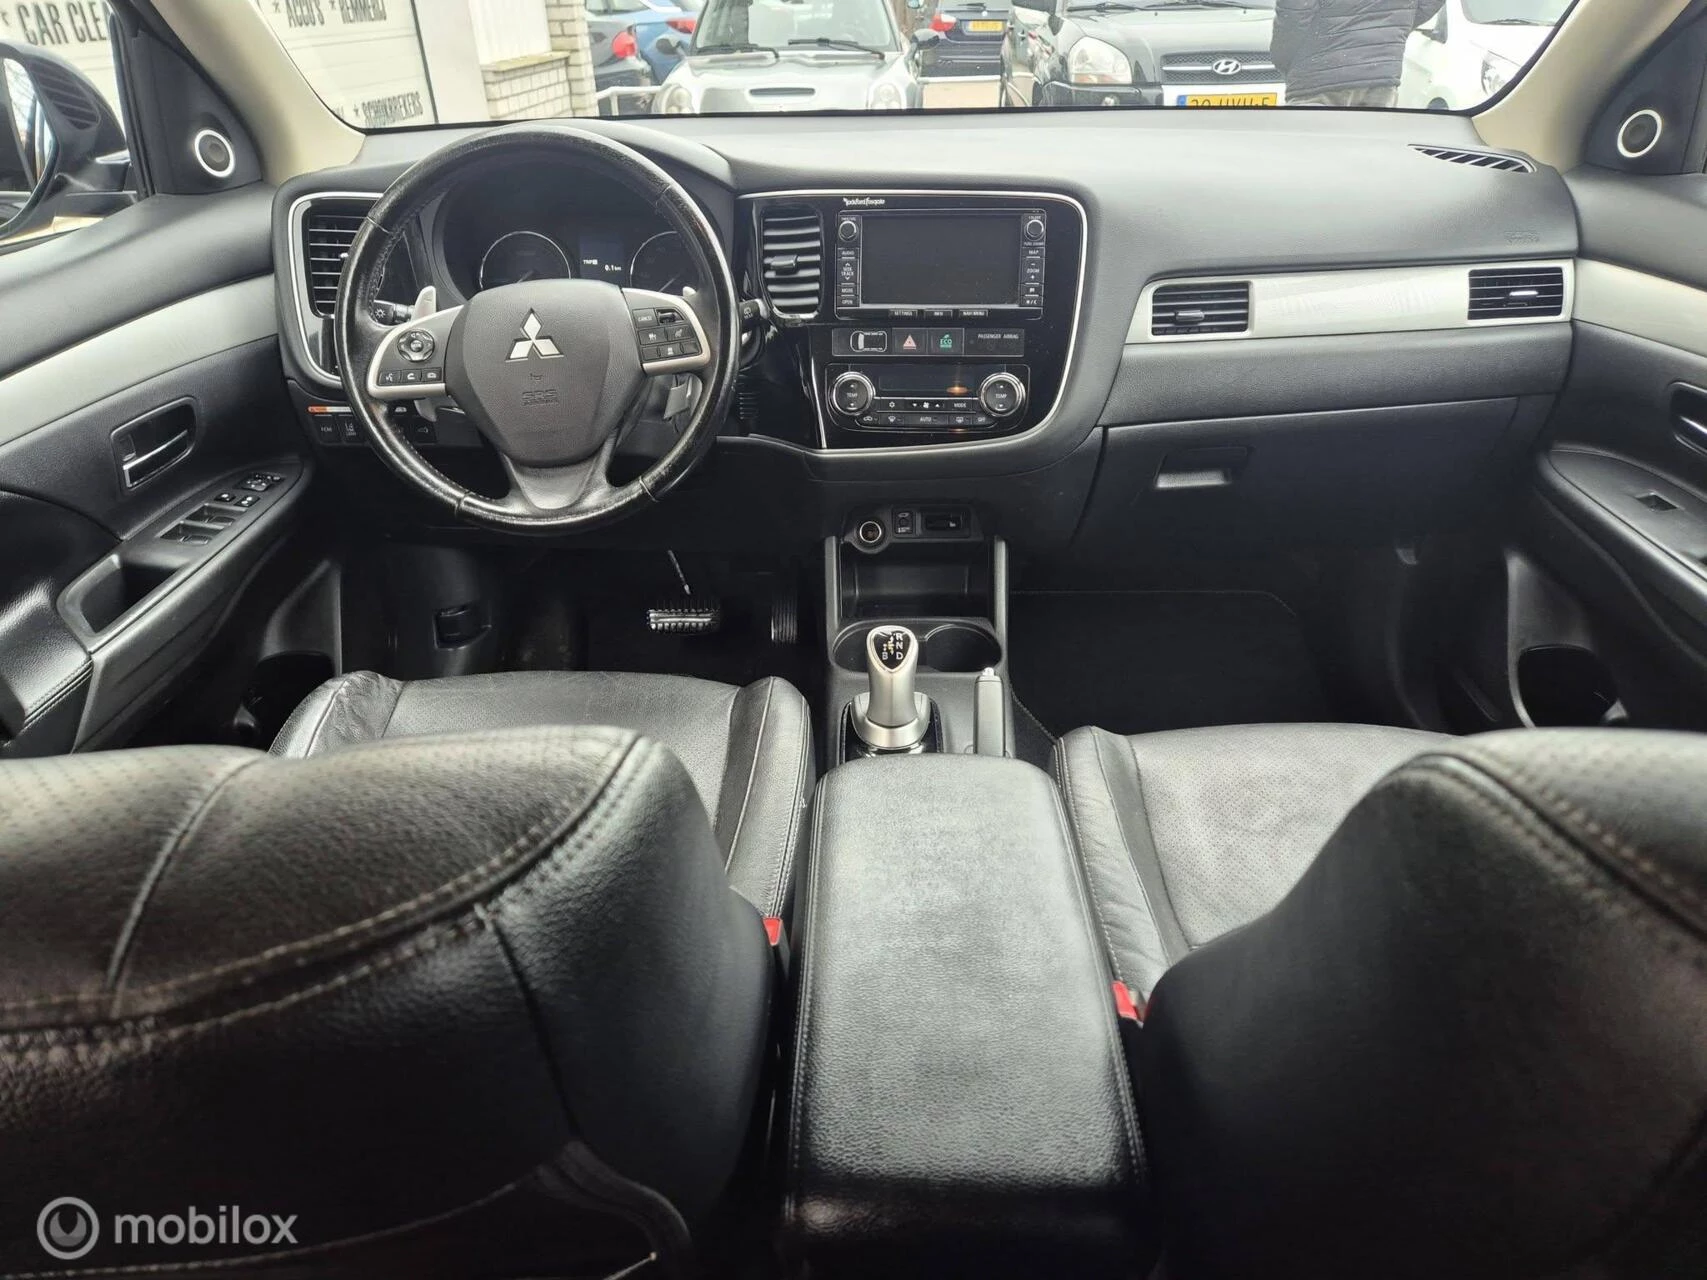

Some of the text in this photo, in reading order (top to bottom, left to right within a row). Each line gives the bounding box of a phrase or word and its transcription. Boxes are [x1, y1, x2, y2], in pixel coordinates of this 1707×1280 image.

[17, 1, 70, 46] CAR
[895, 632, 903, 641] R
[895, 641, 904, 650] N
[882, 651, 889, 660] B
[895, 651, 904, 660] D
